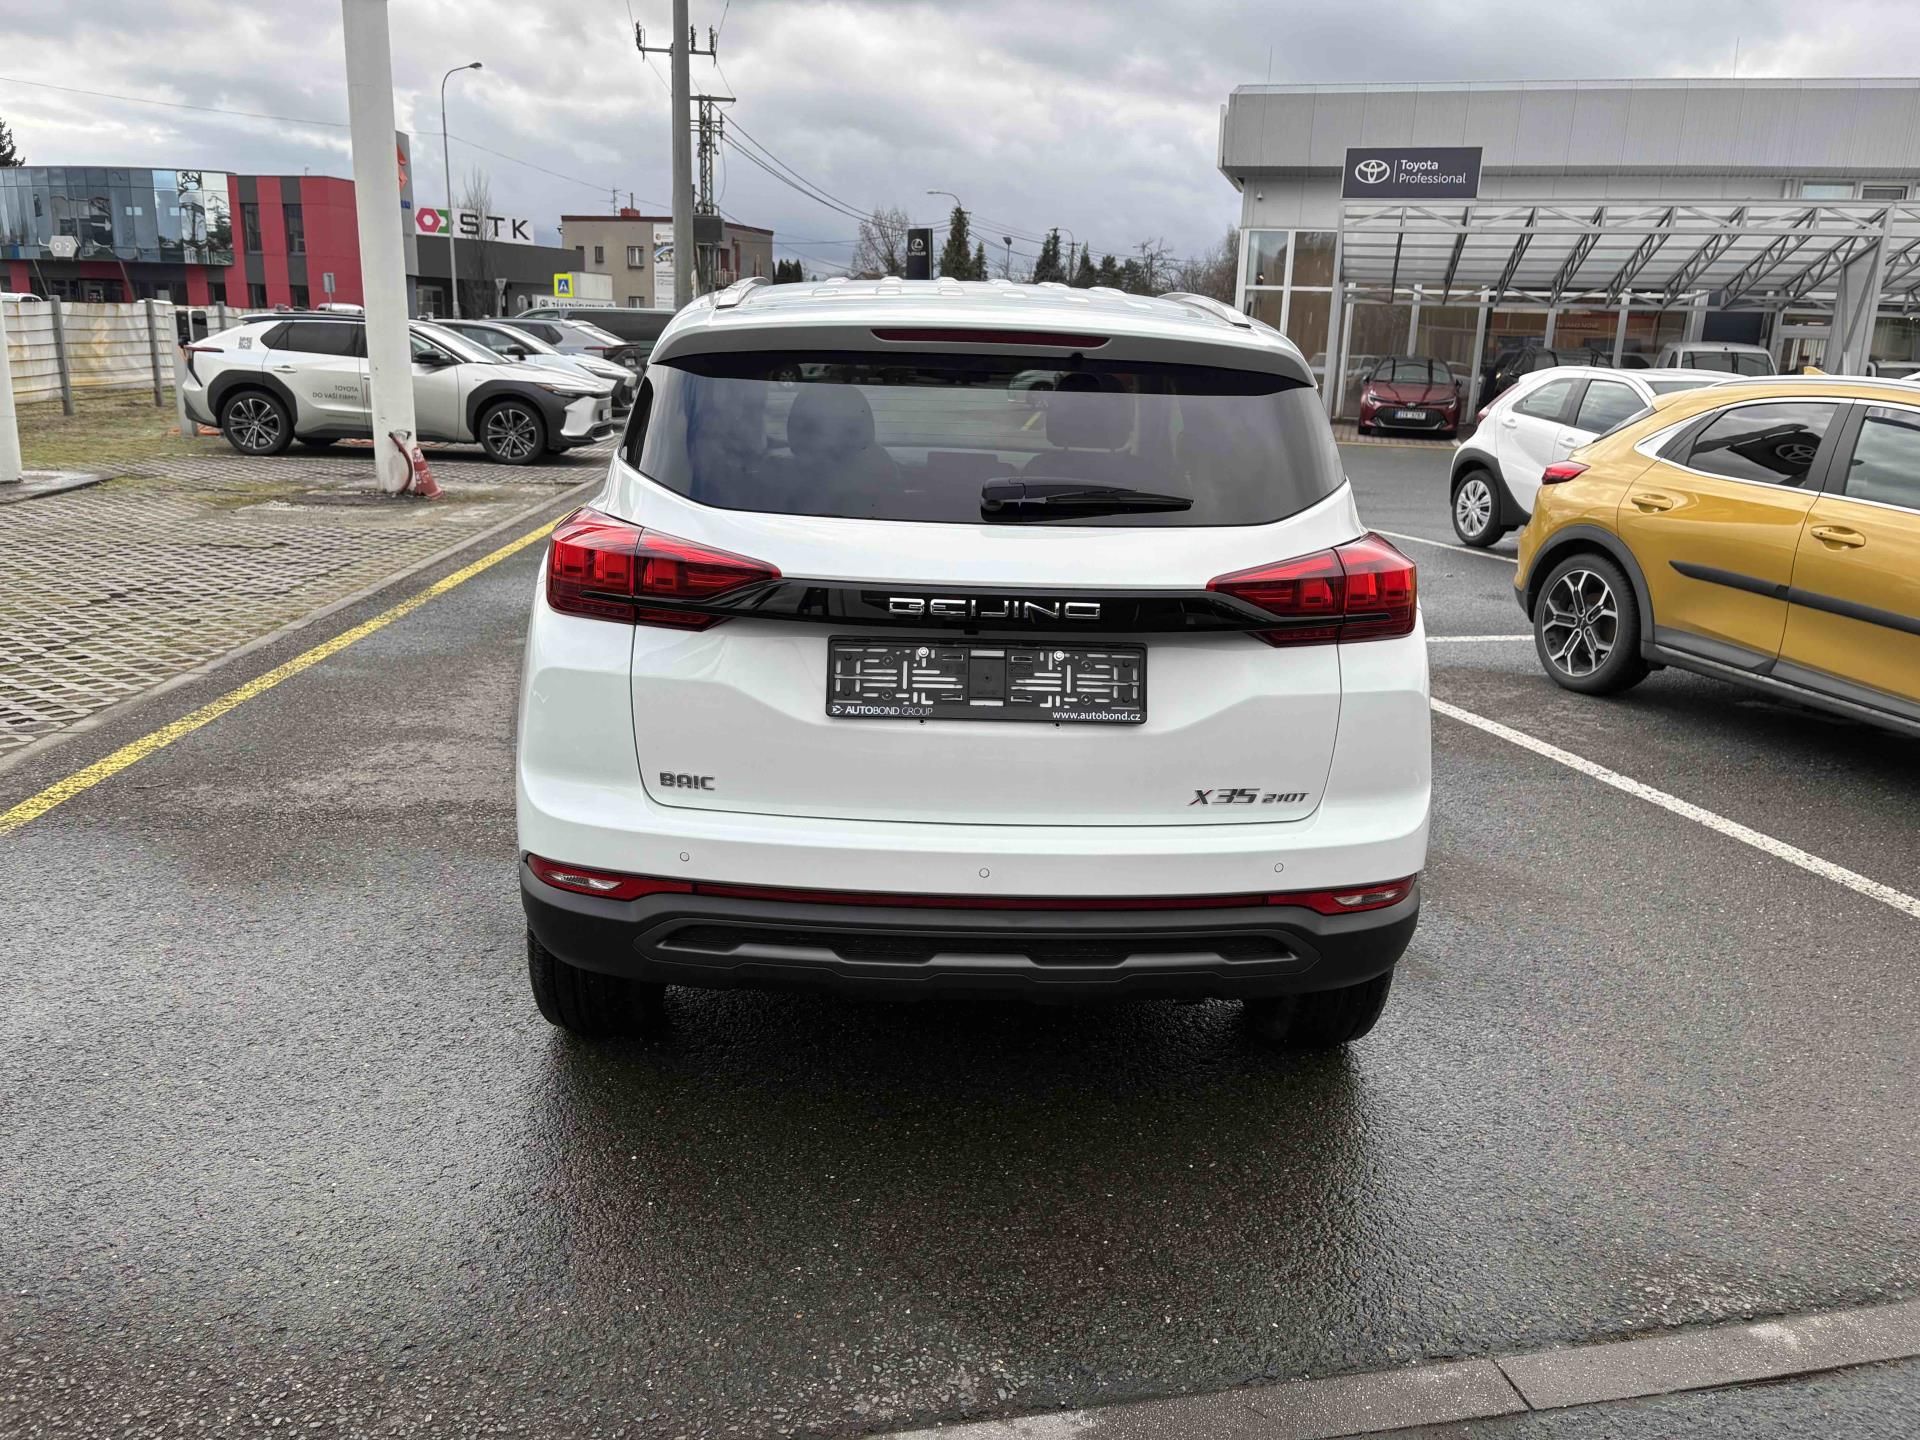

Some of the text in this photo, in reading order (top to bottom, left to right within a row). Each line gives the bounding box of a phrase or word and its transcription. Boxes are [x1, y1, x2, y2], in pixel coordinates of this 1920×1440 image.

[1400, 159, 1439, 172] Toyota
[1399, 172, 1466, 184] Professional
[459, 212, 530, 241] STK
[334, 384, 359, 393] TOYOTA
[312, 391, 323, 399] DO
[889, 597, 1101, 620] BEIJING
[845, 705, 933, 717] AUTOBOND GROUP
[1052, 709, 1141, 721] www.autobond.cz
[659, 772, 715, 791] BAIC
[1187, 788, 1310, 806] X35 210T
